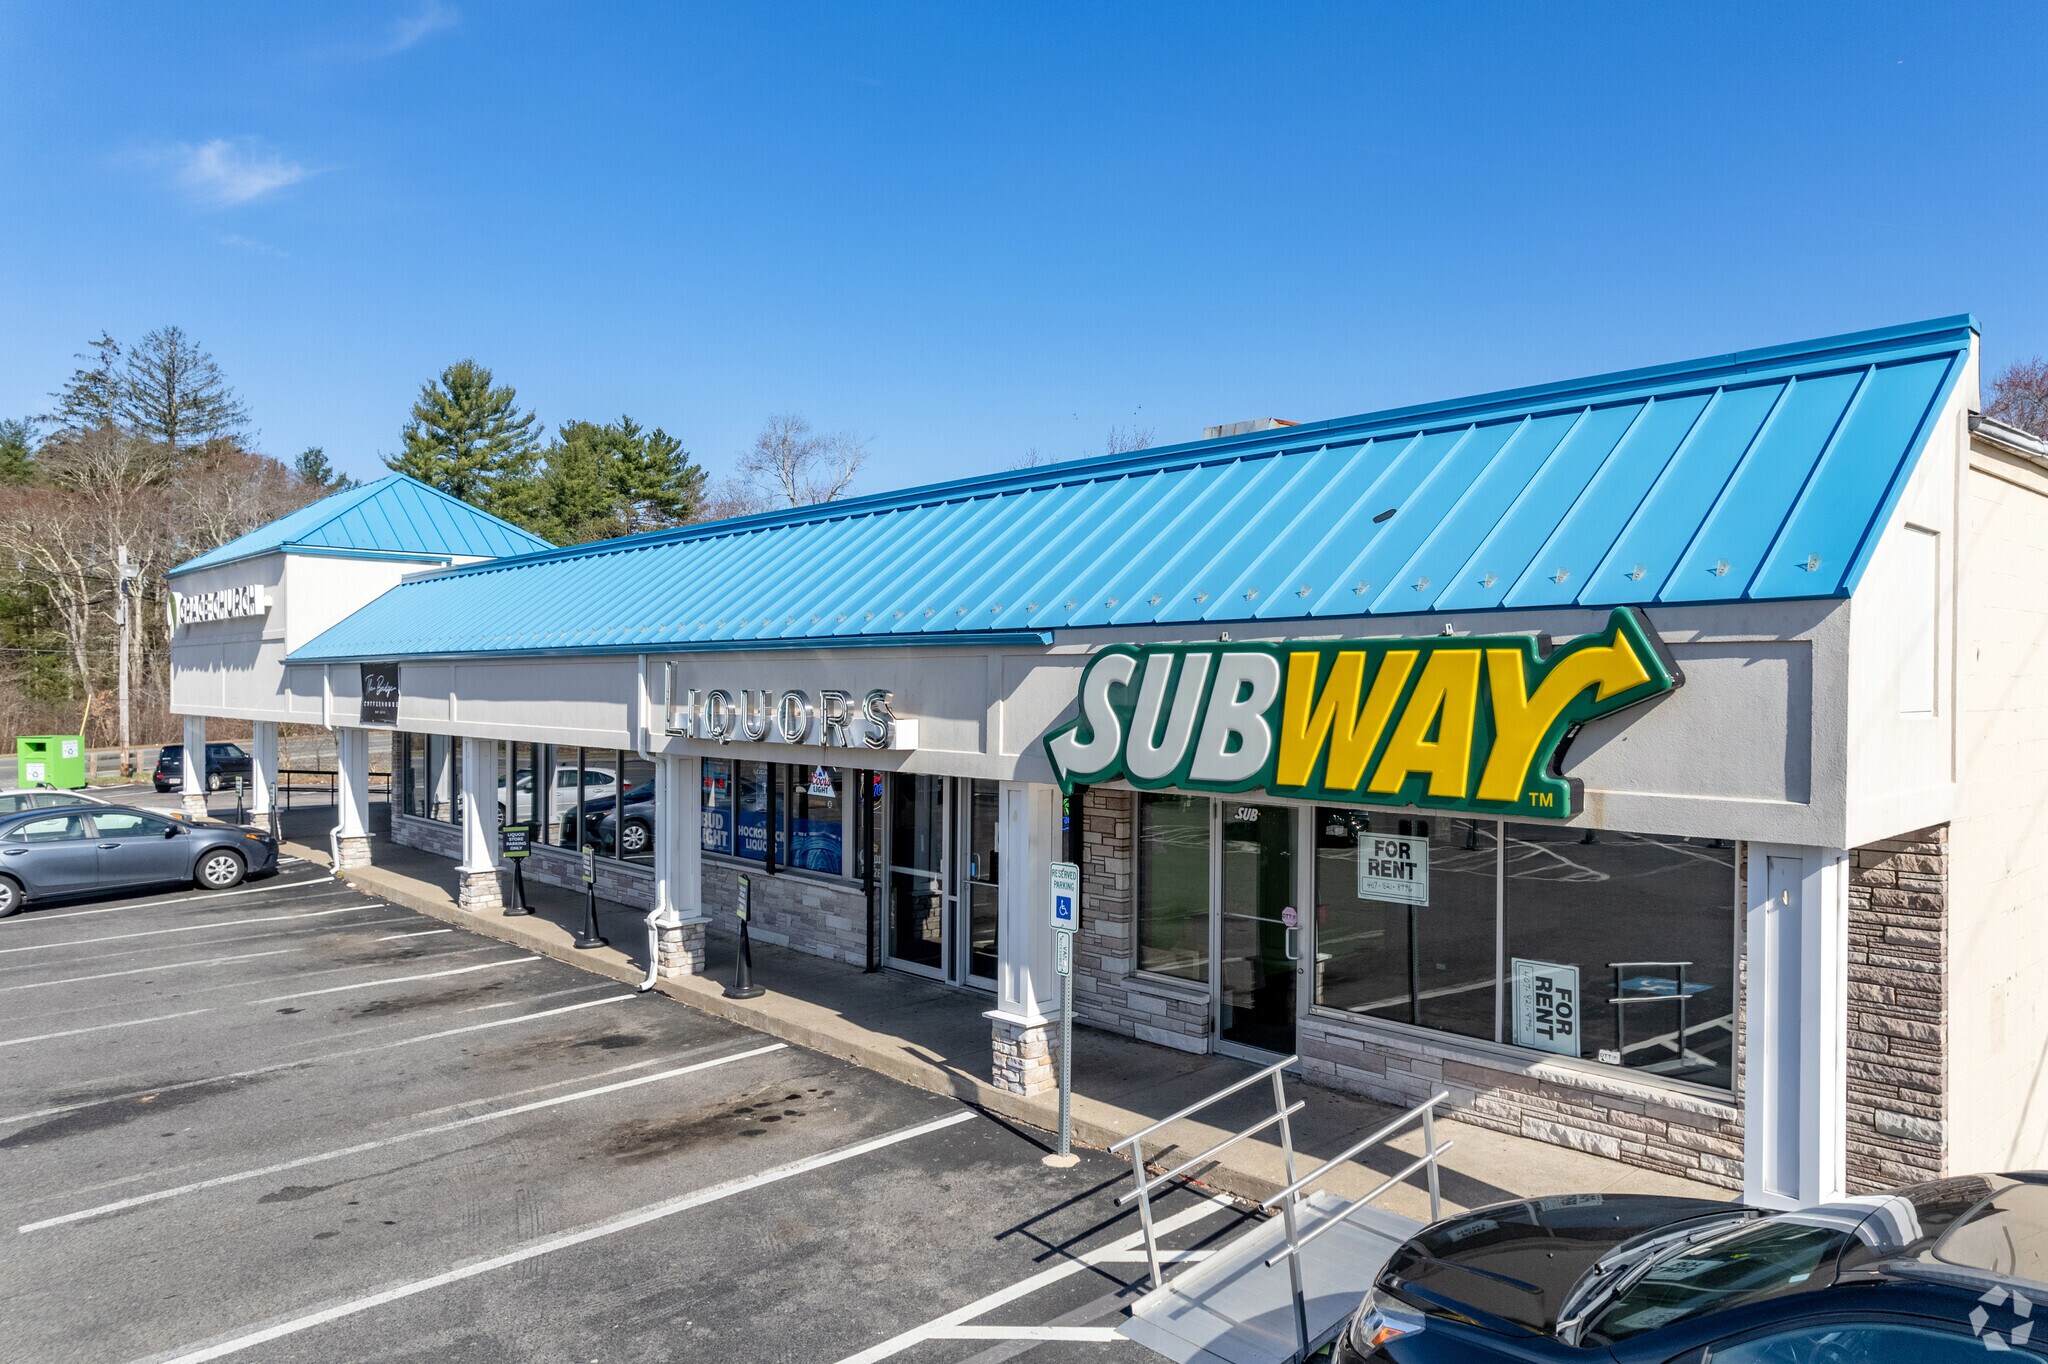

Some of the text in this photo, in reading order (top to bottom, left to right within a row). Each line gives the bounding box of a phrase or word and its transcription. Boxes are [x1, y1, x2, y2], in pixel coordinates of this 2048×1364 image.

[664, 661, 896, 750] LIQUORS
[1049, 628, 1650, 803] SUBWAY
[813, 786, 828, 794] LIGHT
[1235, 807, 1258, 821] SUB
[701, 828, 728, 847] IGHT
[745, 838, 778, 854] LIQUOS
[1375, 840, 1411, 860] FOR
[1052, 868, 1077, 880] RESERVED
[1368, 858, 1417, 880] RENT
[1053, 880, 1074, 891] PARKING
[1535, 976, 1554, 1041] RENT
[1555, 987, 1573, 1036] FOR
